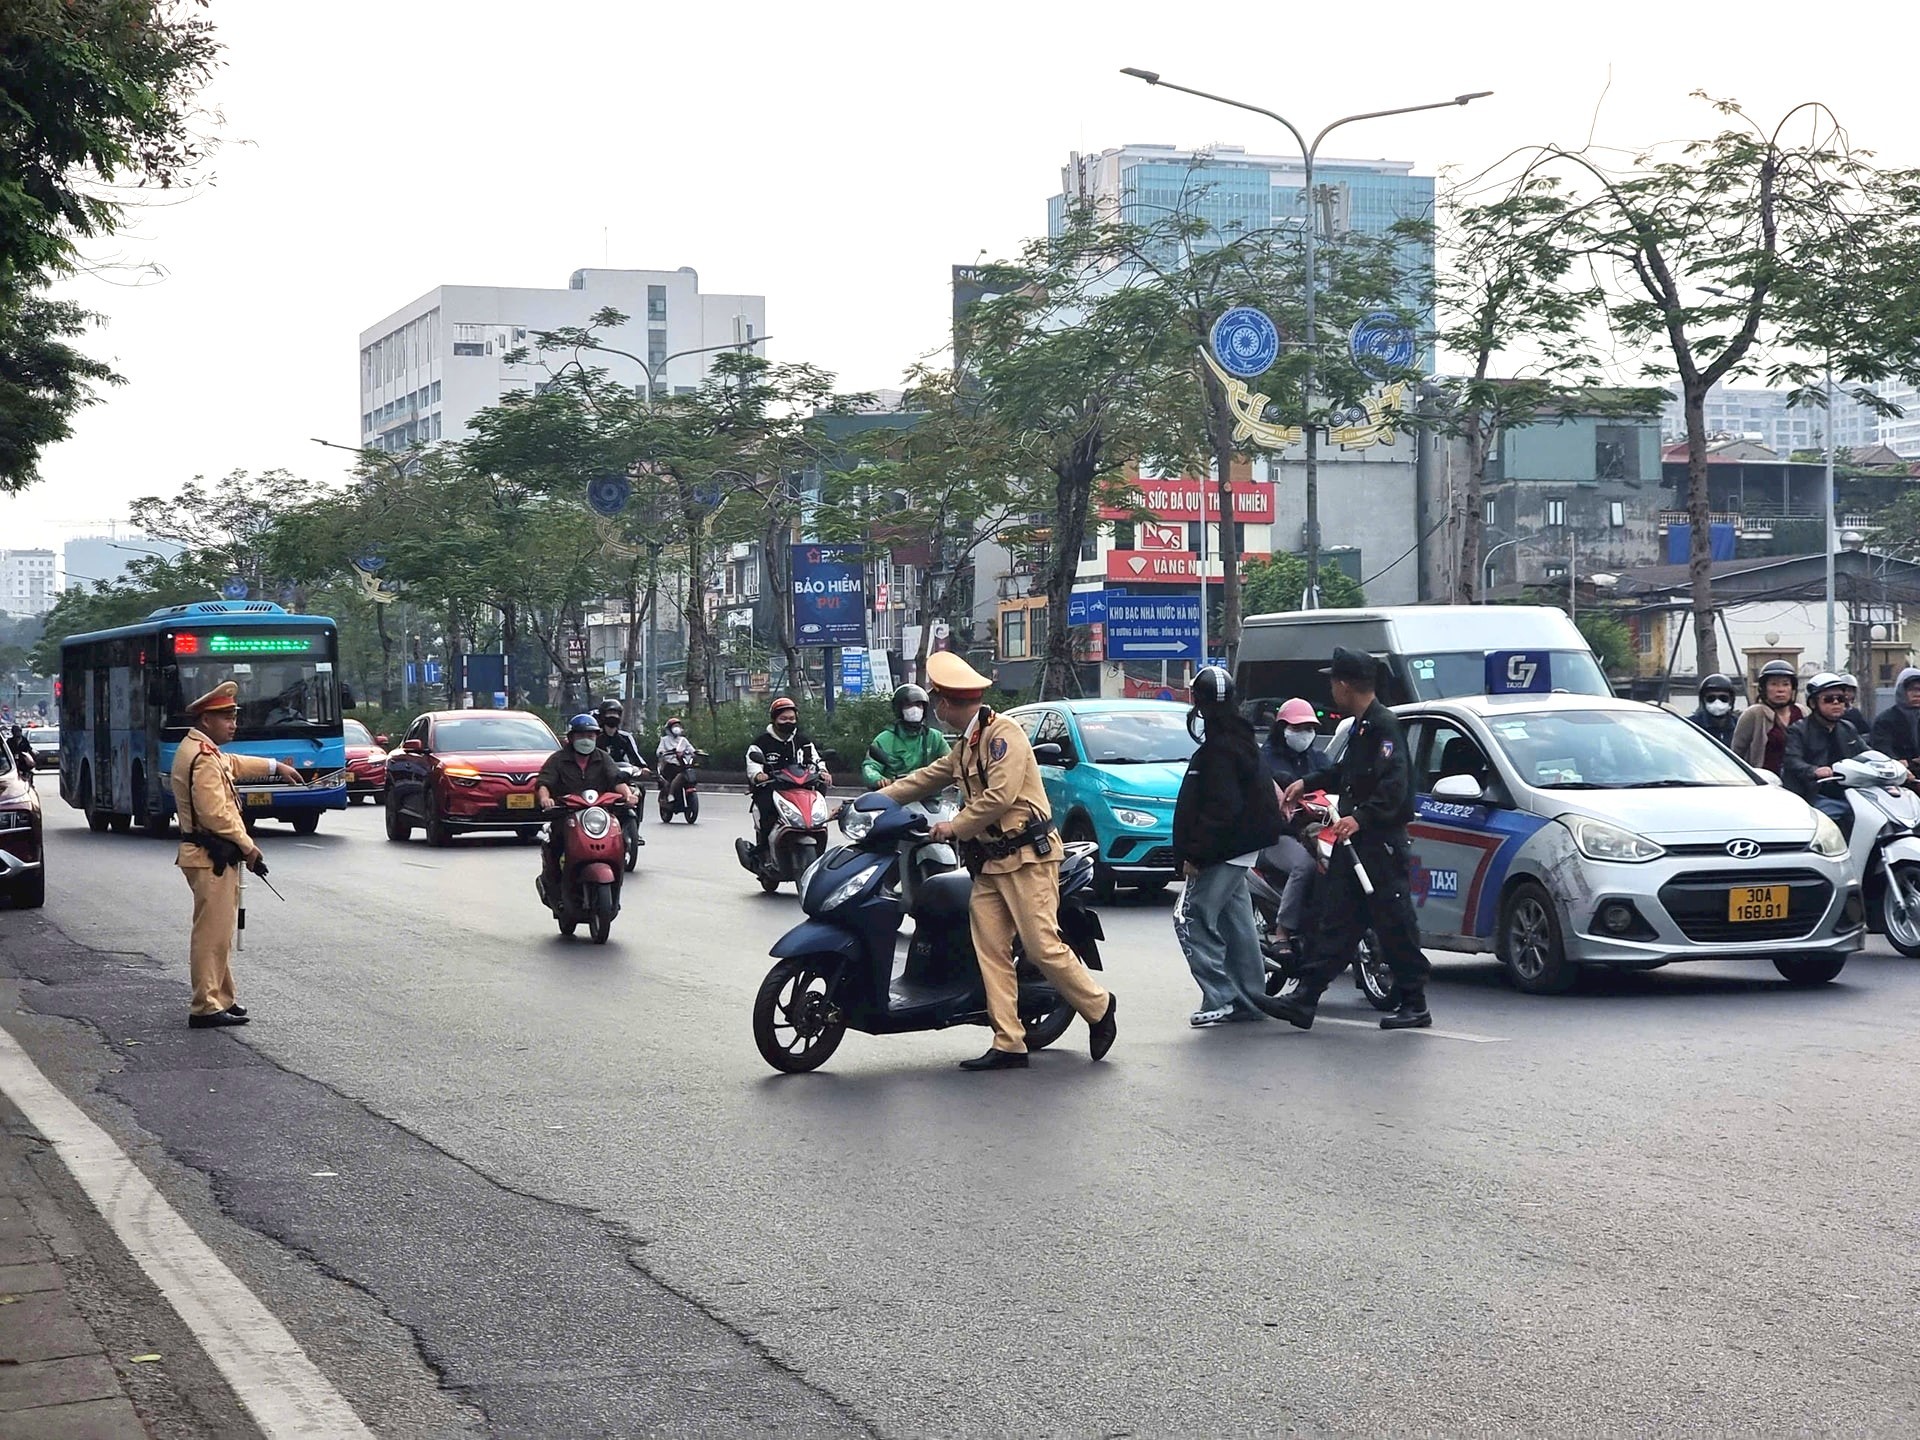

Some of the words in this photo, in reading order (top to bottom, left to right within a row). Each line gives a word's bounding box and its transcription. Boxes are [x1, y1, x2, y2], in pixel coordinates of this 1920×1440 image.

[1149, 487, 1168, 510] SỨC
[1170, 487, 1184, 510] ĐÁ
[1238, 489, 1267, 512] NHIÊN
[1153, 556, 1185, 574] VÀNG
[794, 576, 825, 594] BẢO
[828, 573, 861, 593] HIỂM
[817, 597, 840, 609] PVI
[1109, 606, 1123, 620] KHO
[1125, 606, 1139, 622] BẠC
[1140, 603, 1155, 620] NHÀ
[1157, 603, 1174, 620] NƯỚC
[1176, 603, 1185, 620] HÀ
[1187, 603, 1199, 622] NỘI
[1430, 870, 1457, 891] TAXI
[1747, 888, 1772, 903] 30A
[1737, 903, 1782, 920] 168.81
